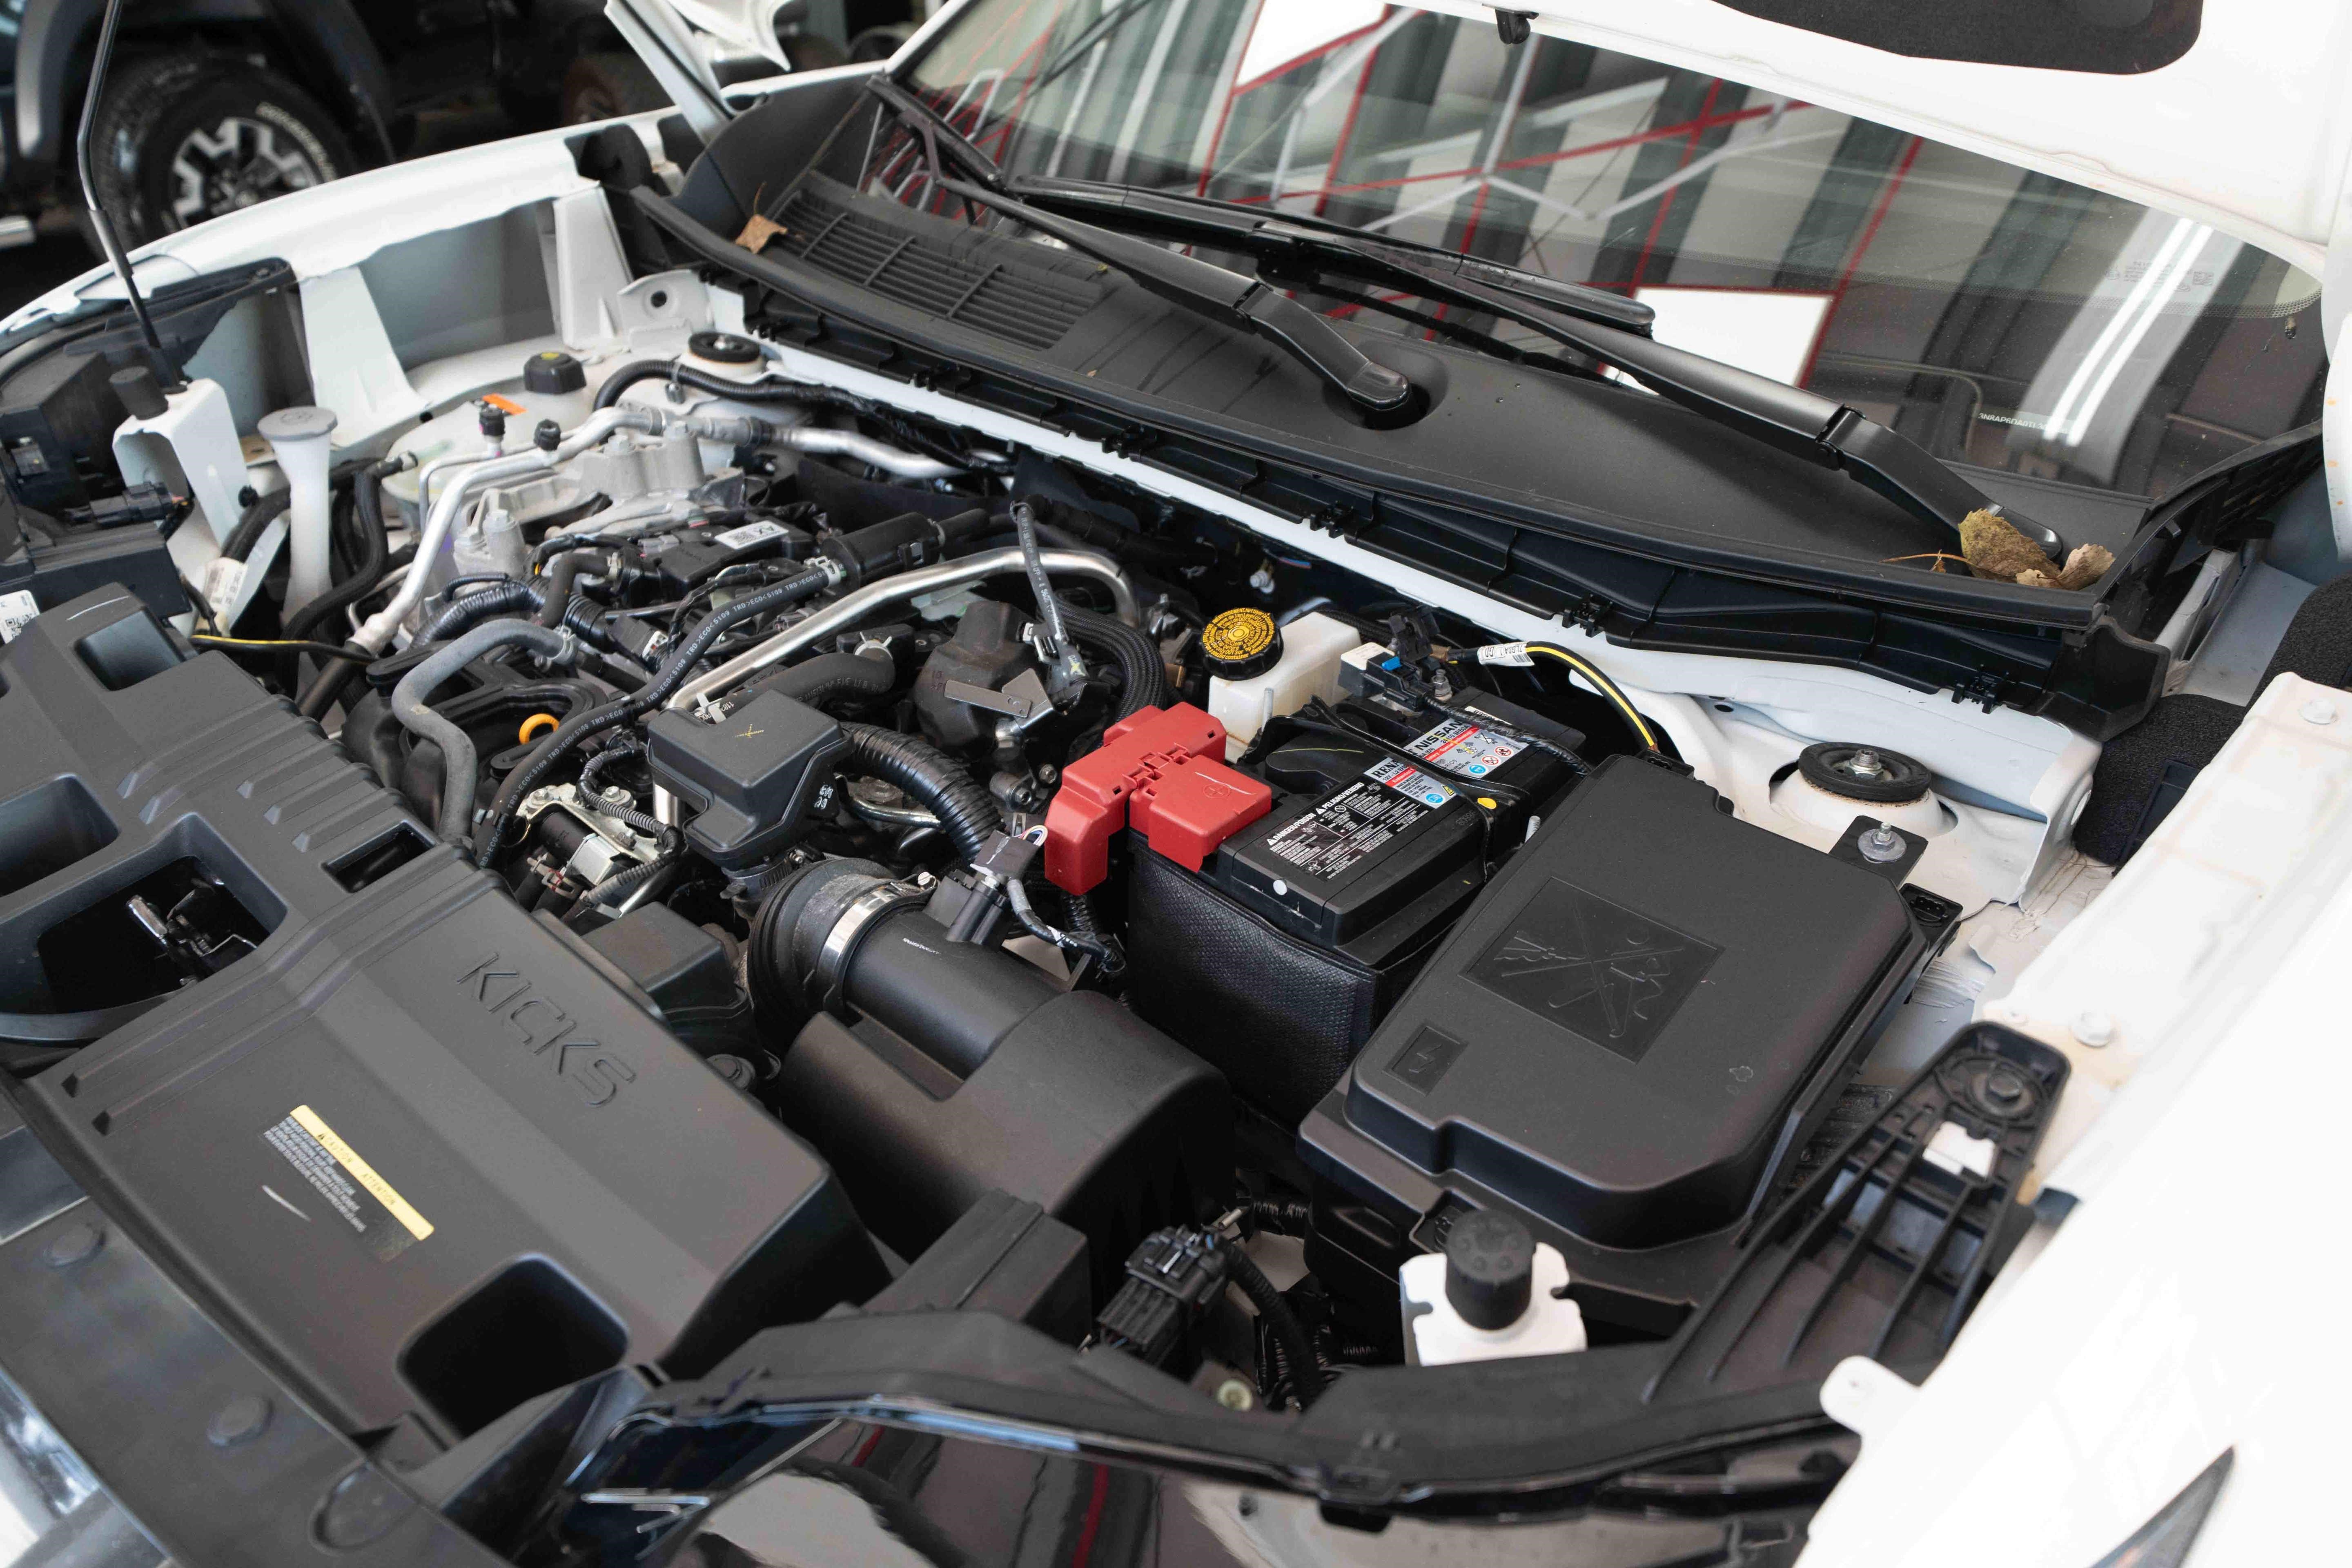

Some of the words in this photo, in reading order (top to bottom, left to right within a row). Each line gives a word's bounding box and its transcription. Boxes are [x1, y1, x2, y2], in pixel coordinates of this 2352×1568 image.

[1414, 720, 1463, 751] NISSAN
[1273, 812, 1317, 840] DANGER/POISON
[1321, 782, 1365, 809] PELIGRO/VENENO
[457, 951, 637, 1108] KICKS
